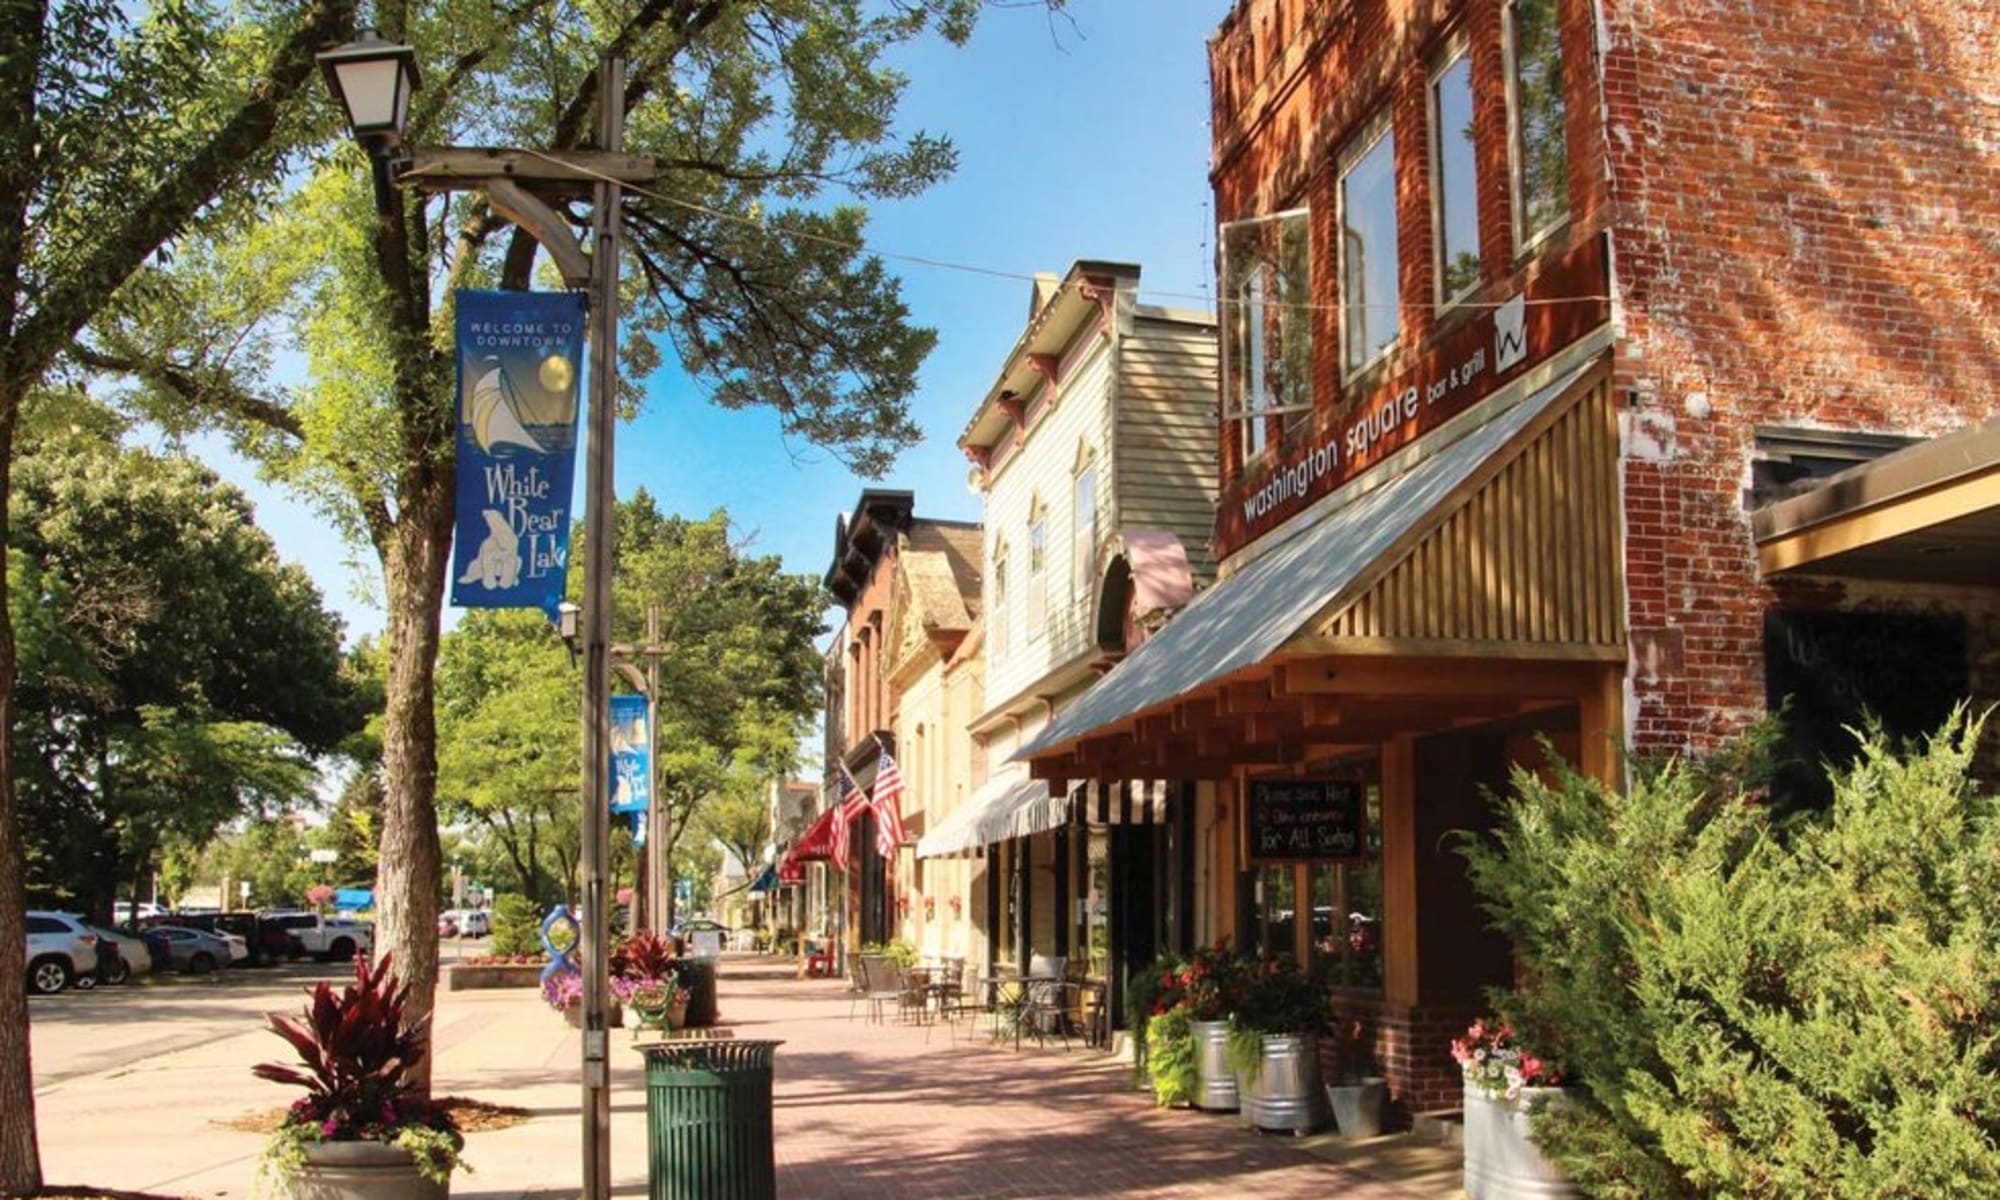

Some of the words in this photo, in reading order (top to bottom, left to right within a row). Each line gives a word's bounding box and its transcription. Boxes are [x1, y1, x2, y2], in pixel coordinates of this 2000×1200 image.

[470, 323, 544, 334] WELCOME
[552, 323, 572, 334] TO
[476, 336, 566, 347] DOWNTOWN
[1243, 439, 1339, 522] washington
[1345, 385, 1419, 458] square
[1426, 377, 1447, 405] bar
[1450, 367, 1460, 389] &
[1461, 346, 1485, 386] grill
[482, 462, 551, 505] White
[507, 496, 565, 538] Bear
[526, 533, 567, 578] Lak
